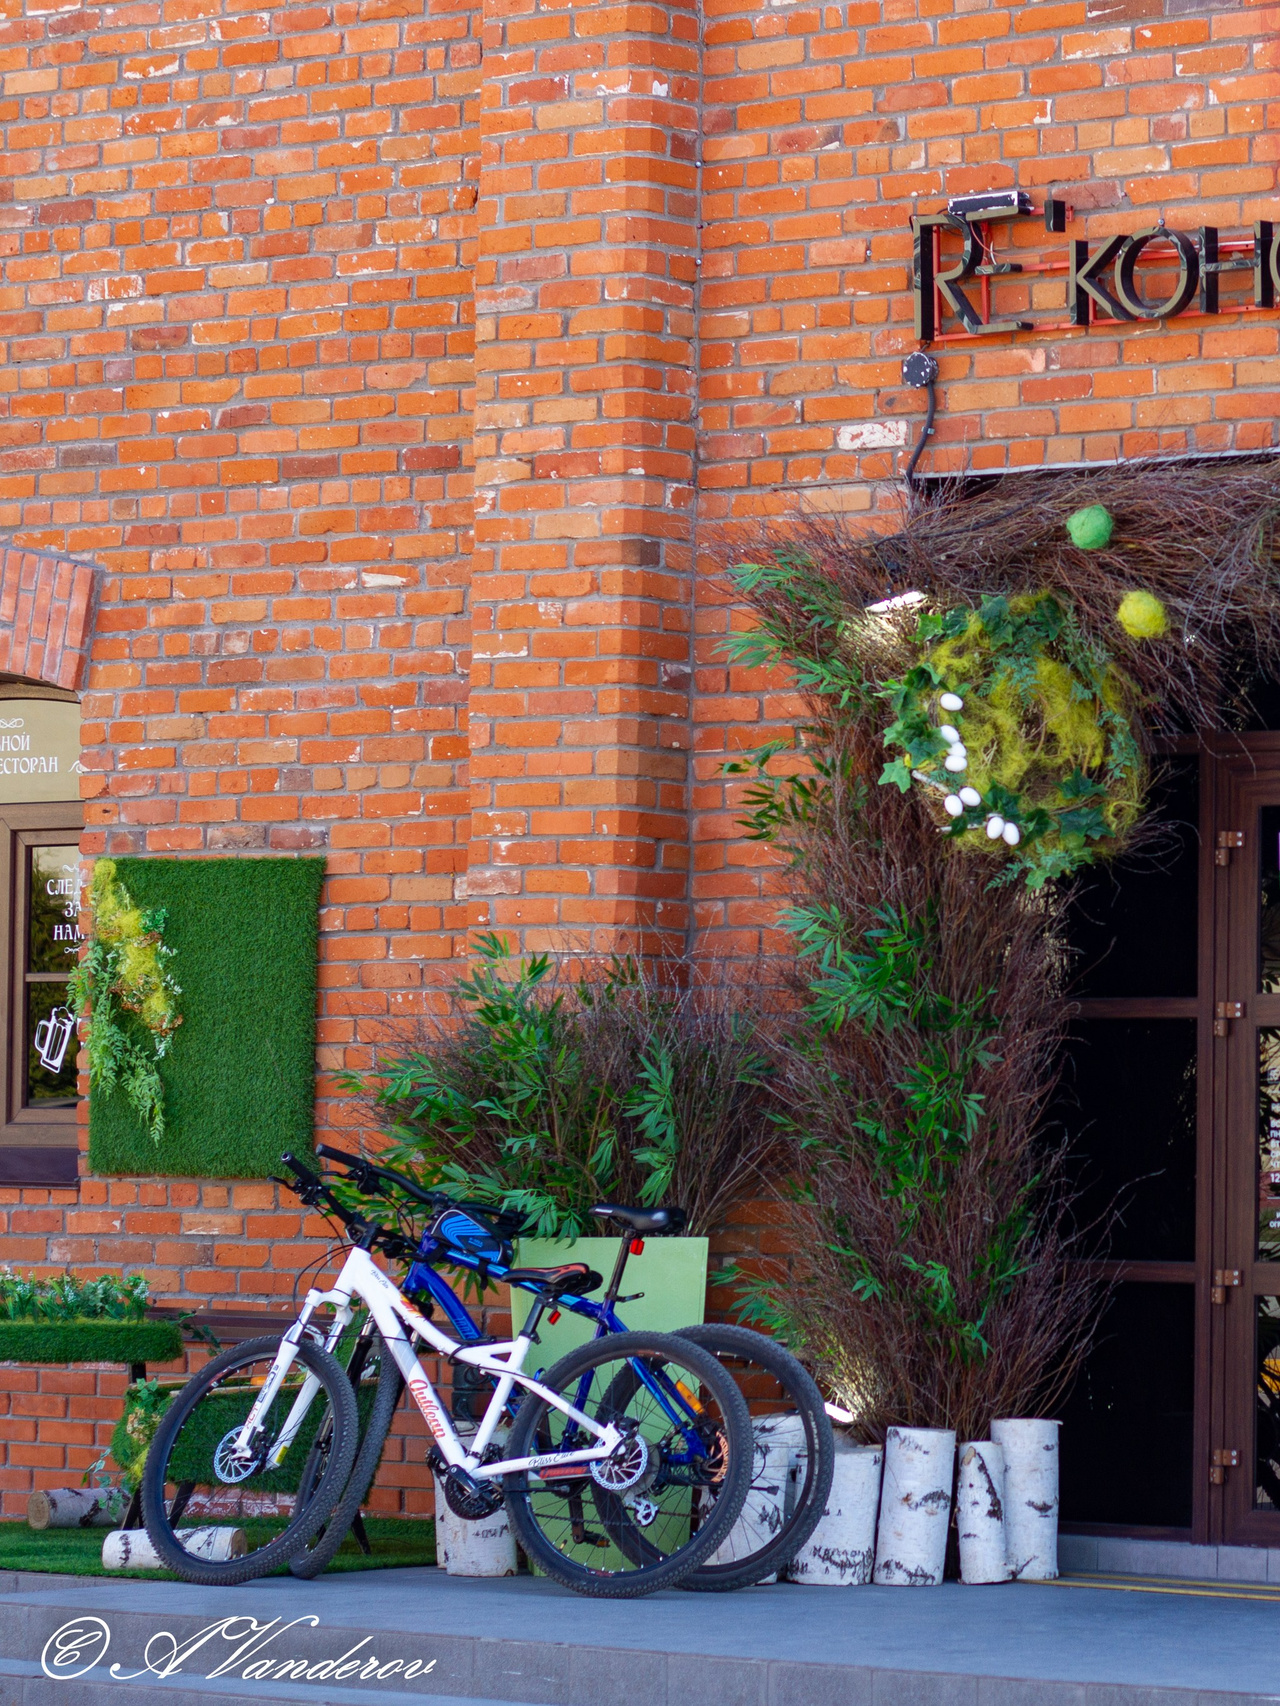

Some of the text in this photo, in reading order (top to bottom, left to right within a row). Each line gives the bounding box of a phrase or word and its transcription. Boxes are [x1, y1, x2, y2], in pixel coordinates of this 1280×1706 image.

[0, 732, 31, 751] НОЙ
[1270, 1130, 1280, 1138] ПН
[1270, 1160, 1280, 1168] ЧТ
[409, 1379, 446, 1438] Outleap
